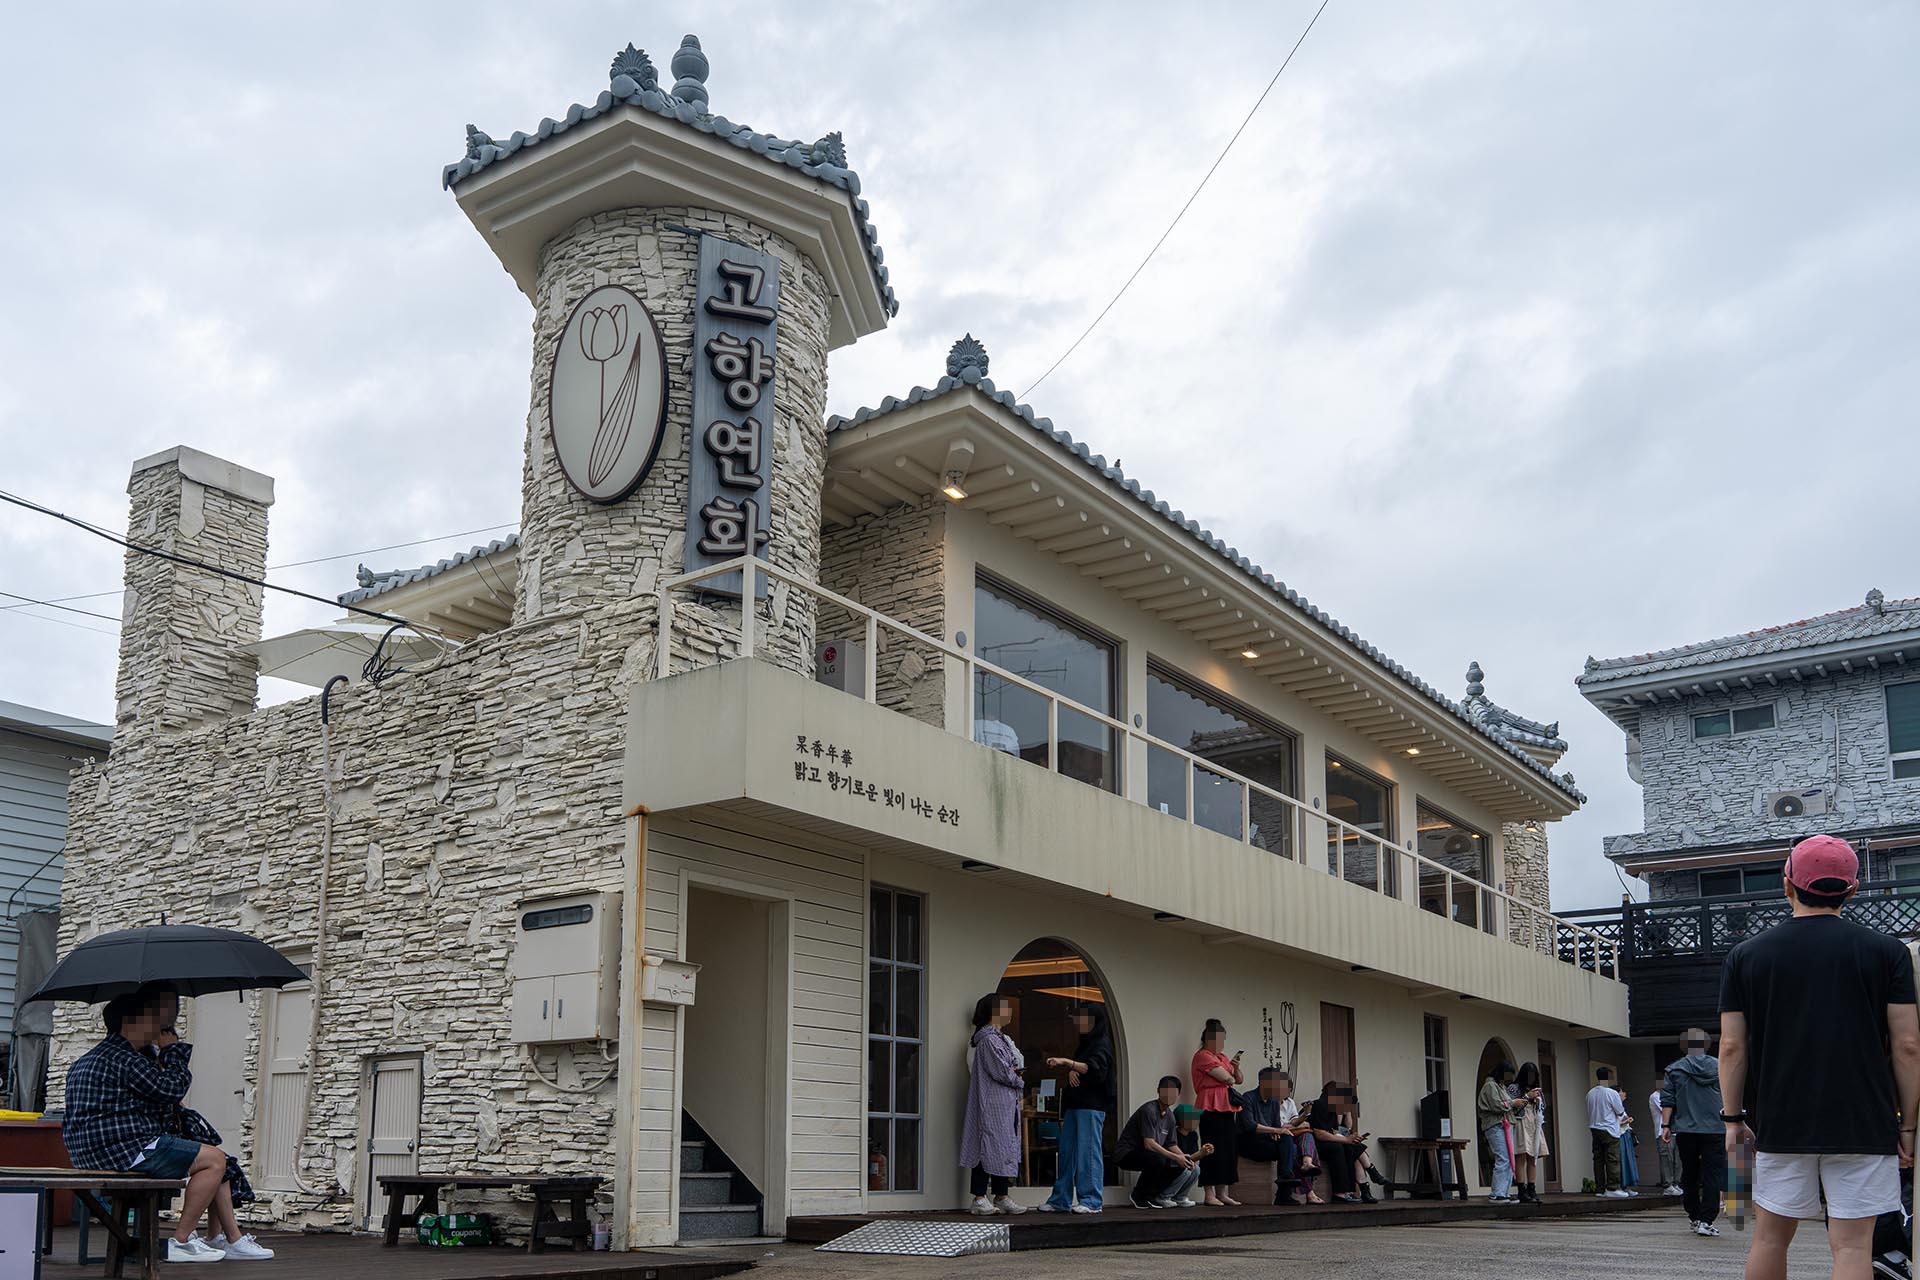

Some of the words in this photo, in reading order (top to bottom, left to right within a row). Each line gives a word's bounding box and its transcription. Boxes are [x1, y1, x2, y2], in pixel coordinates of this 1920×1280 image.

[697, 258, 777, 568] 고향연화
[824, 664, 836, 675] LG
[795, 761, 822, 783] 밝고
[827, 770, 878, 802] 향기로운
[883, 788, 905, 811] 빛이
[910, 796, 933, 818] 나는
[937, 804, 960, 827] 순간
[451, 1229, 481, 1238] coupang
